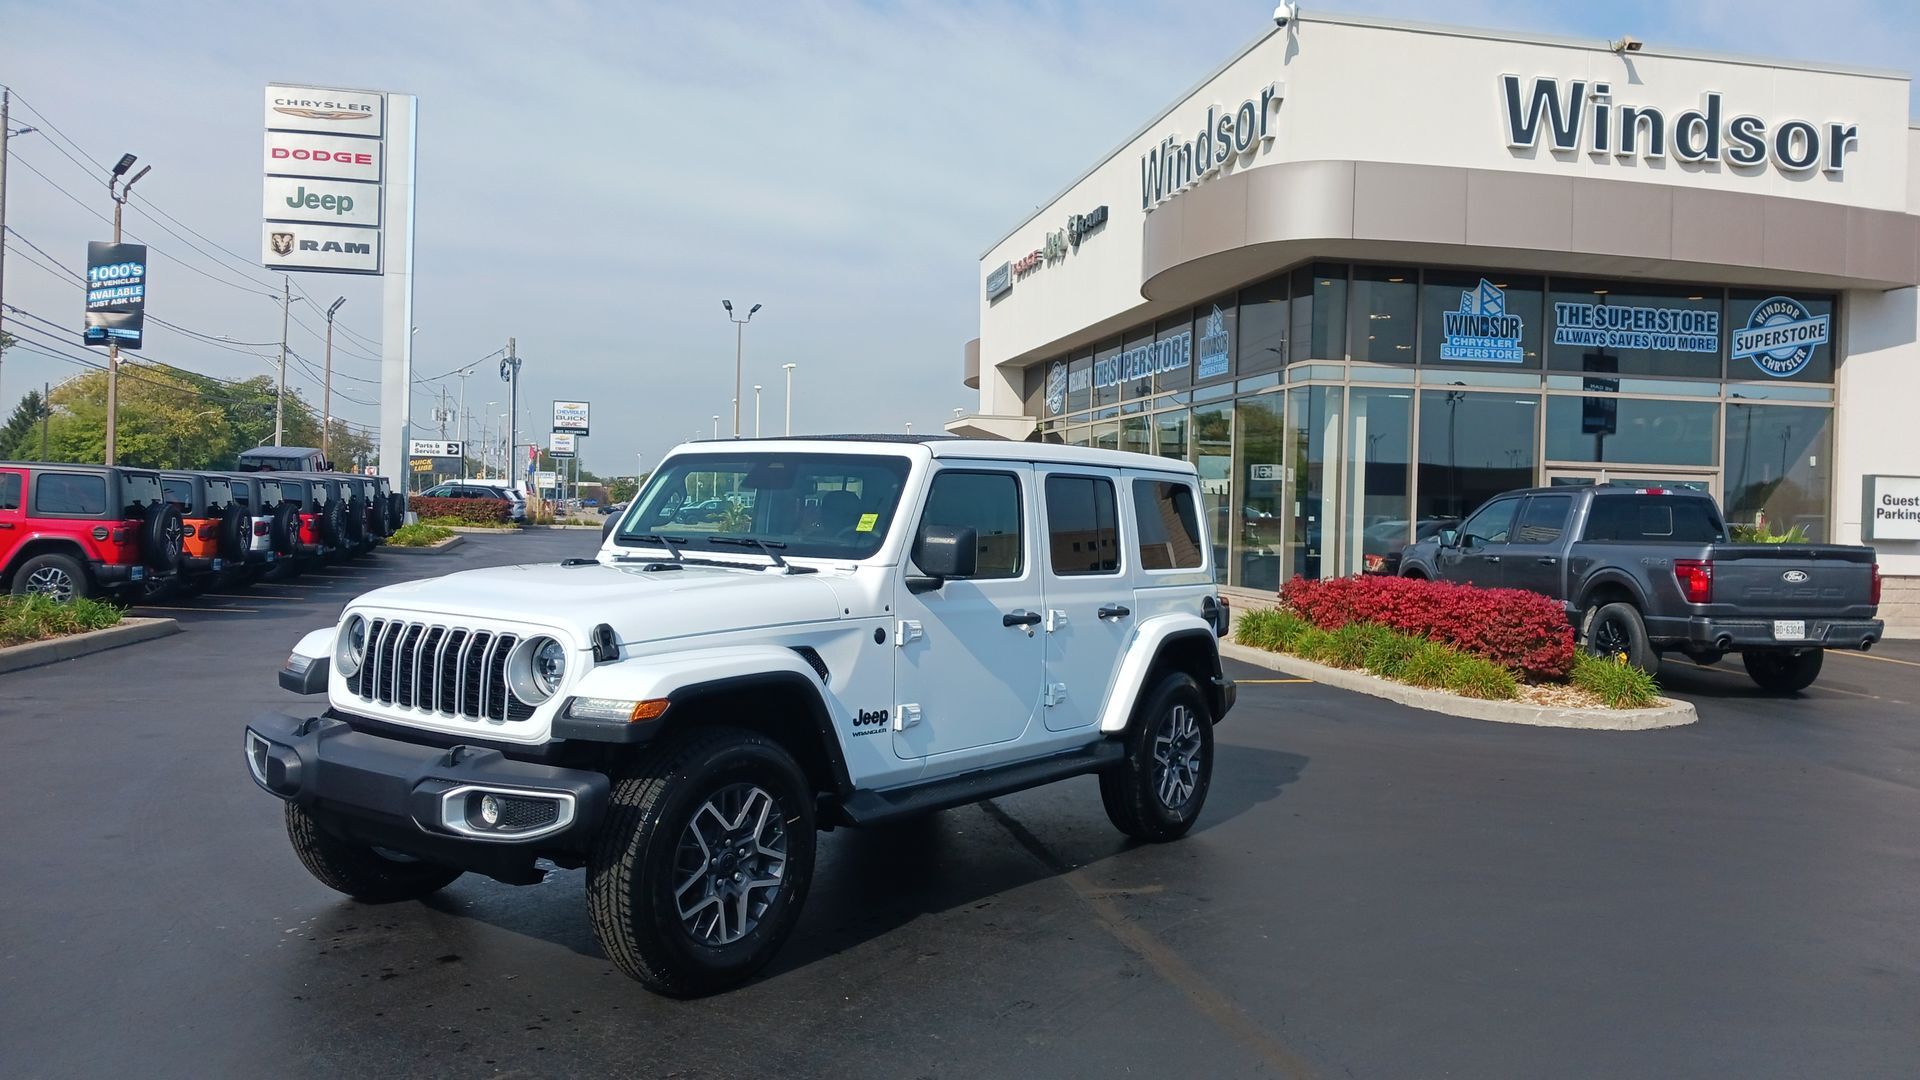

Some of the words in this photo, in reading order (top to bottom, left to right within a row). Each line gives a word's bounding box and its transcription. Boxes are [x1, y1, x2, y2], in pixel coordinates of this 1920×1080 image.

[274, 98, 372, 111] CHRYSLER
[1499, 74, 1858, 172] Windsor
[1140, 81, 1284, 212] Windsor
[272, 148, 372, 165] DODGE
[286, 186, 354, 215] Jeep
[300, 239, 370, 254] RAM
[89, 263, 143, 281] 1000's
[103, 277, 140, 287] VEHICLES
[90, 286, 142, 300] AVAILABLE
[89, 300, 110, 308] JUST
[111, 297, 128, 305] ASK
[1556, 304, 1592, 327] THE
[1594, 305, 1718, 333] SUPERSTORE
[1755, 302, 1800, 324] WINDSOR
[1446, 314, 1520, 339] WINDSOR
[1452, 337, 1512, 348] CHRYSLER
[1556, 329, 1606, 346] ALWAYS
[1609, 331, 1649, 347] SAVES
[1651, 334, 1676, 348] YOU
[1678, 336, 1717, 351] MORE!
[1736, 323, 1825, 352] SUPERSTORE
[1095, 361, 1108, 388] THE
[1109, 332, 1190, 386] SUPERSTORE
[1444, 347, 1520, 359] SUPERSTORE
[1762, 348, 1807, 373] CHRYSLER
[410, 458, 432, 466] QUICK
[1882, 494, 1920, 506] Guest
[852, 708, 888, 726] Jeep
[852, 728, 887, 737] WRANGLER
